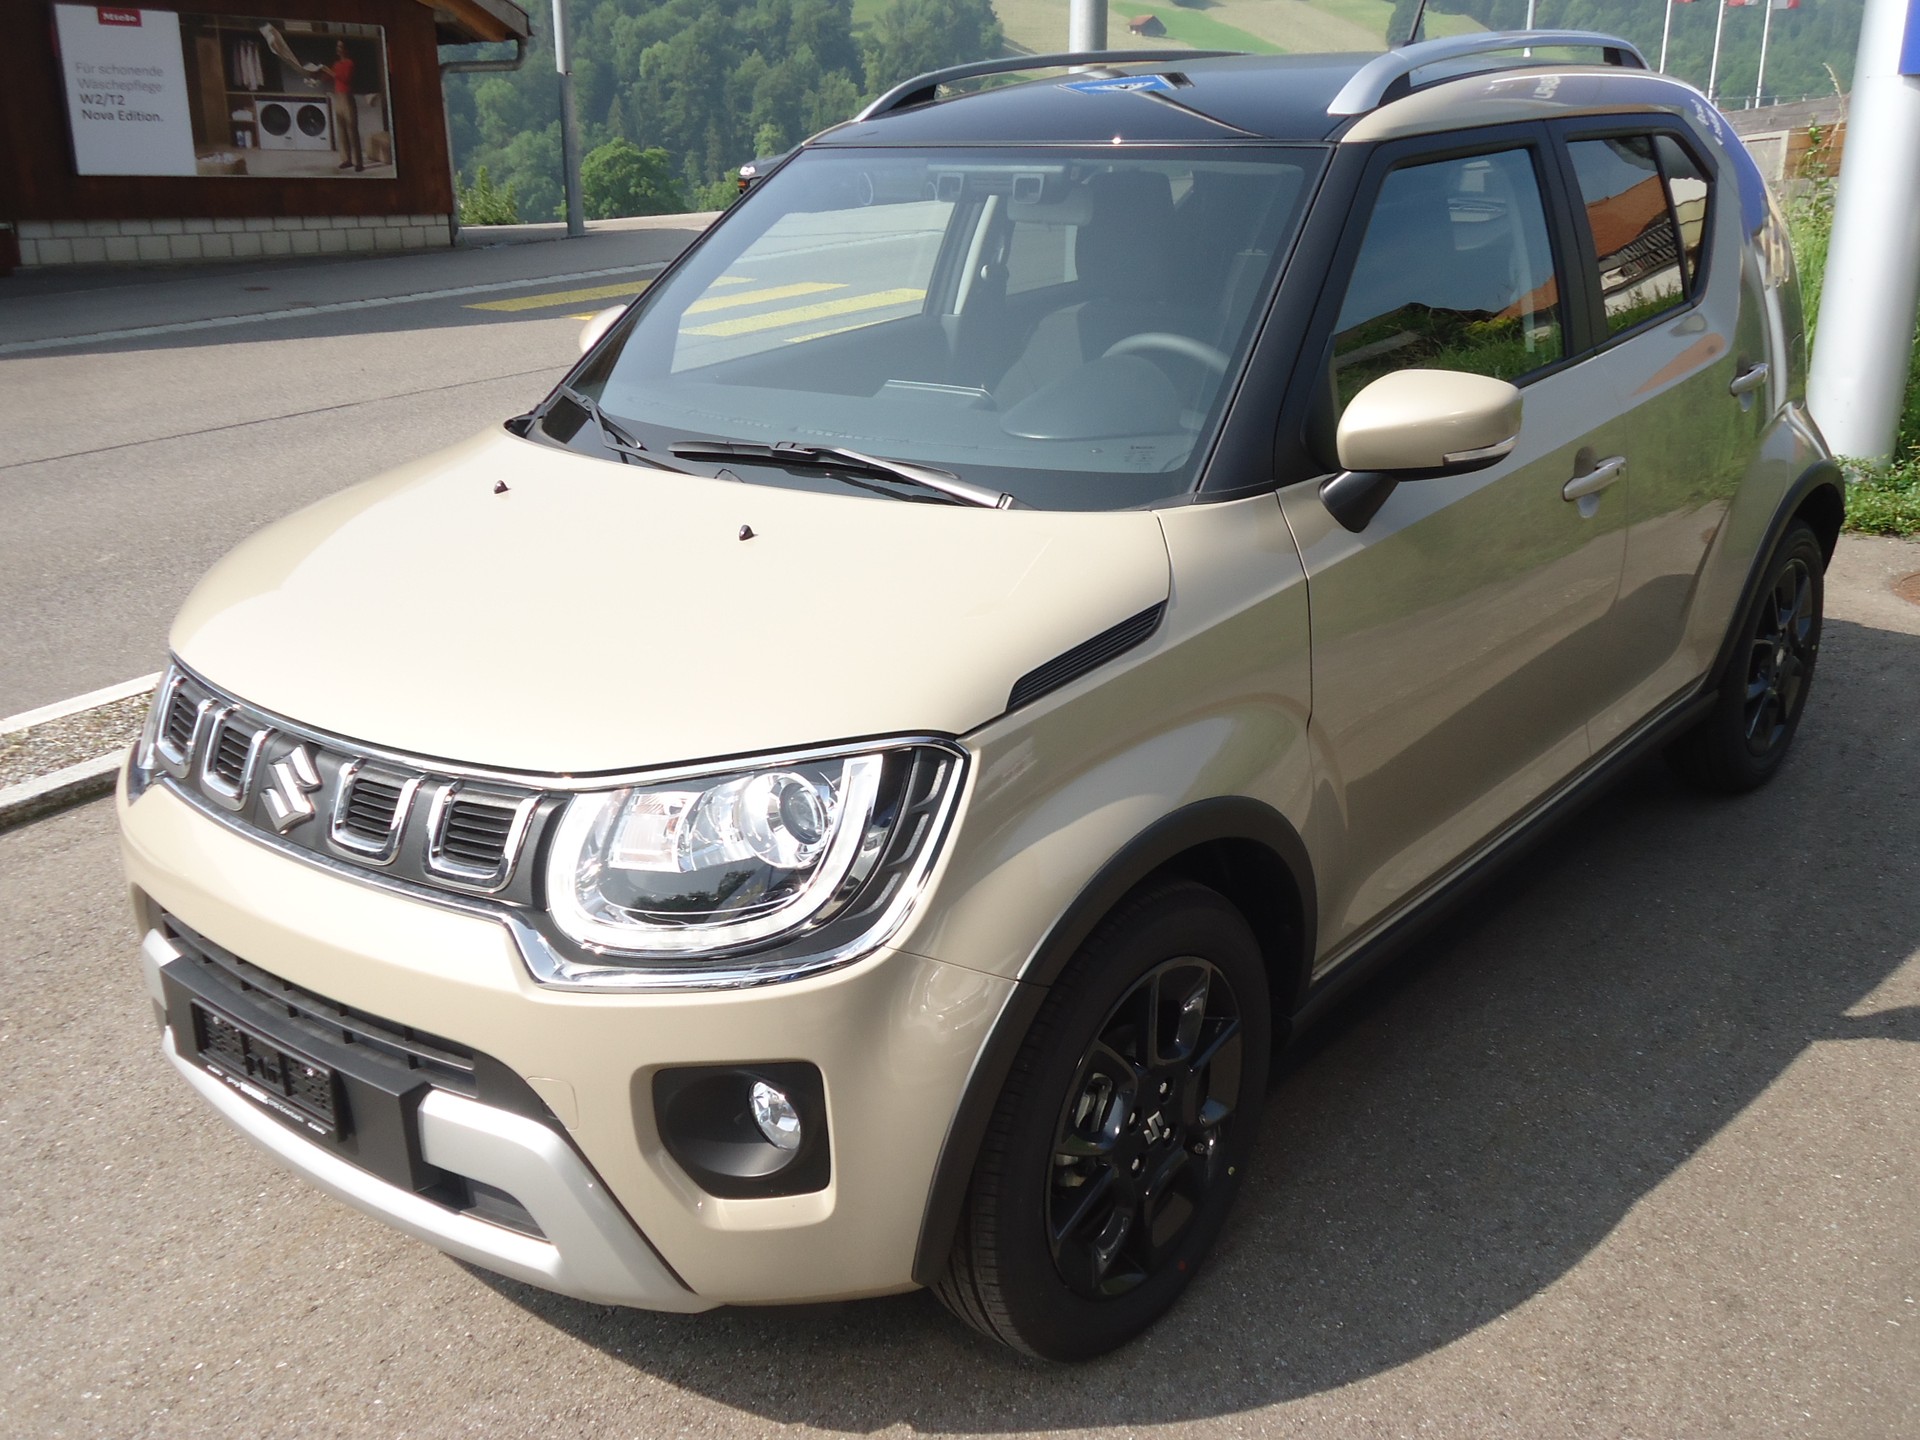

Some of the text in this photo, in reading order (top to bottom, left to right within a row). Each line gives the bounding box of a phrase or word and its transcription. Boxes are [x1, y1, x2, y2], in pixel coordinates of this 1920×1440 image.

[103, 12, 137, 22] Miele
[75, 62, 163, 77] Für schonende
[79, 92, 126, 107] W2/T2
[81, 108, 164, 122] Nova Edition.
